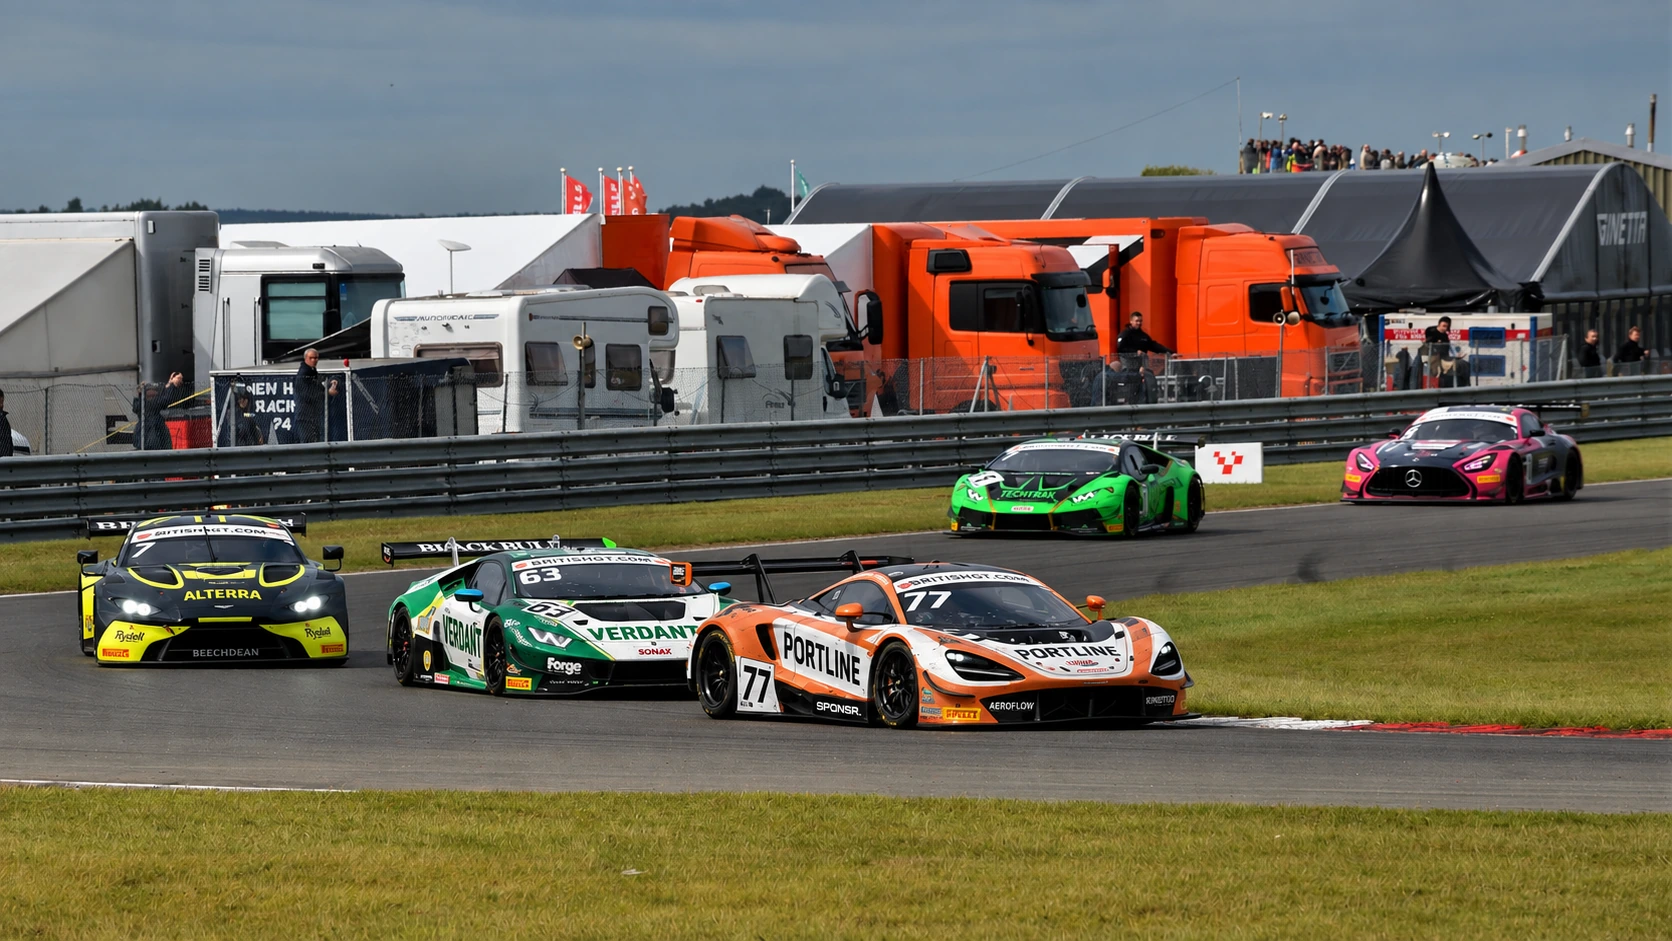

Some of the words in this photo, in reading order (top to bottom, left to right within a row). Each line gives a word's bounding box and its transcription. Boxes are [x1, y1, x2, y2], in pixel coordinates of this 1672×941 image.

[1597, 211, 1647, 246] GINETTA
[131, 542, 156, 558] 7
[519, 567, 562, 585] 63
[184, 589, 262, 601] ALTERRA
[904, 591, 952, 612] 77
[527, 602, 576, 618] 63
[442, 614, 482, 658] VERDANT
[587, 625, 698, 641] VERDANT
[192, 648, 259, 657] BEECHDEAN
[784, 631, 860, 686] PORTLINE
[1014, 646, 1121, 660] PORTLINE
[547, 657, 582, 675] Forge
[743, 665, 771, 703] 77
[816, 701, 862, 716] SPONSR.
[989, 702, 1034, 710] AEROFLOW
